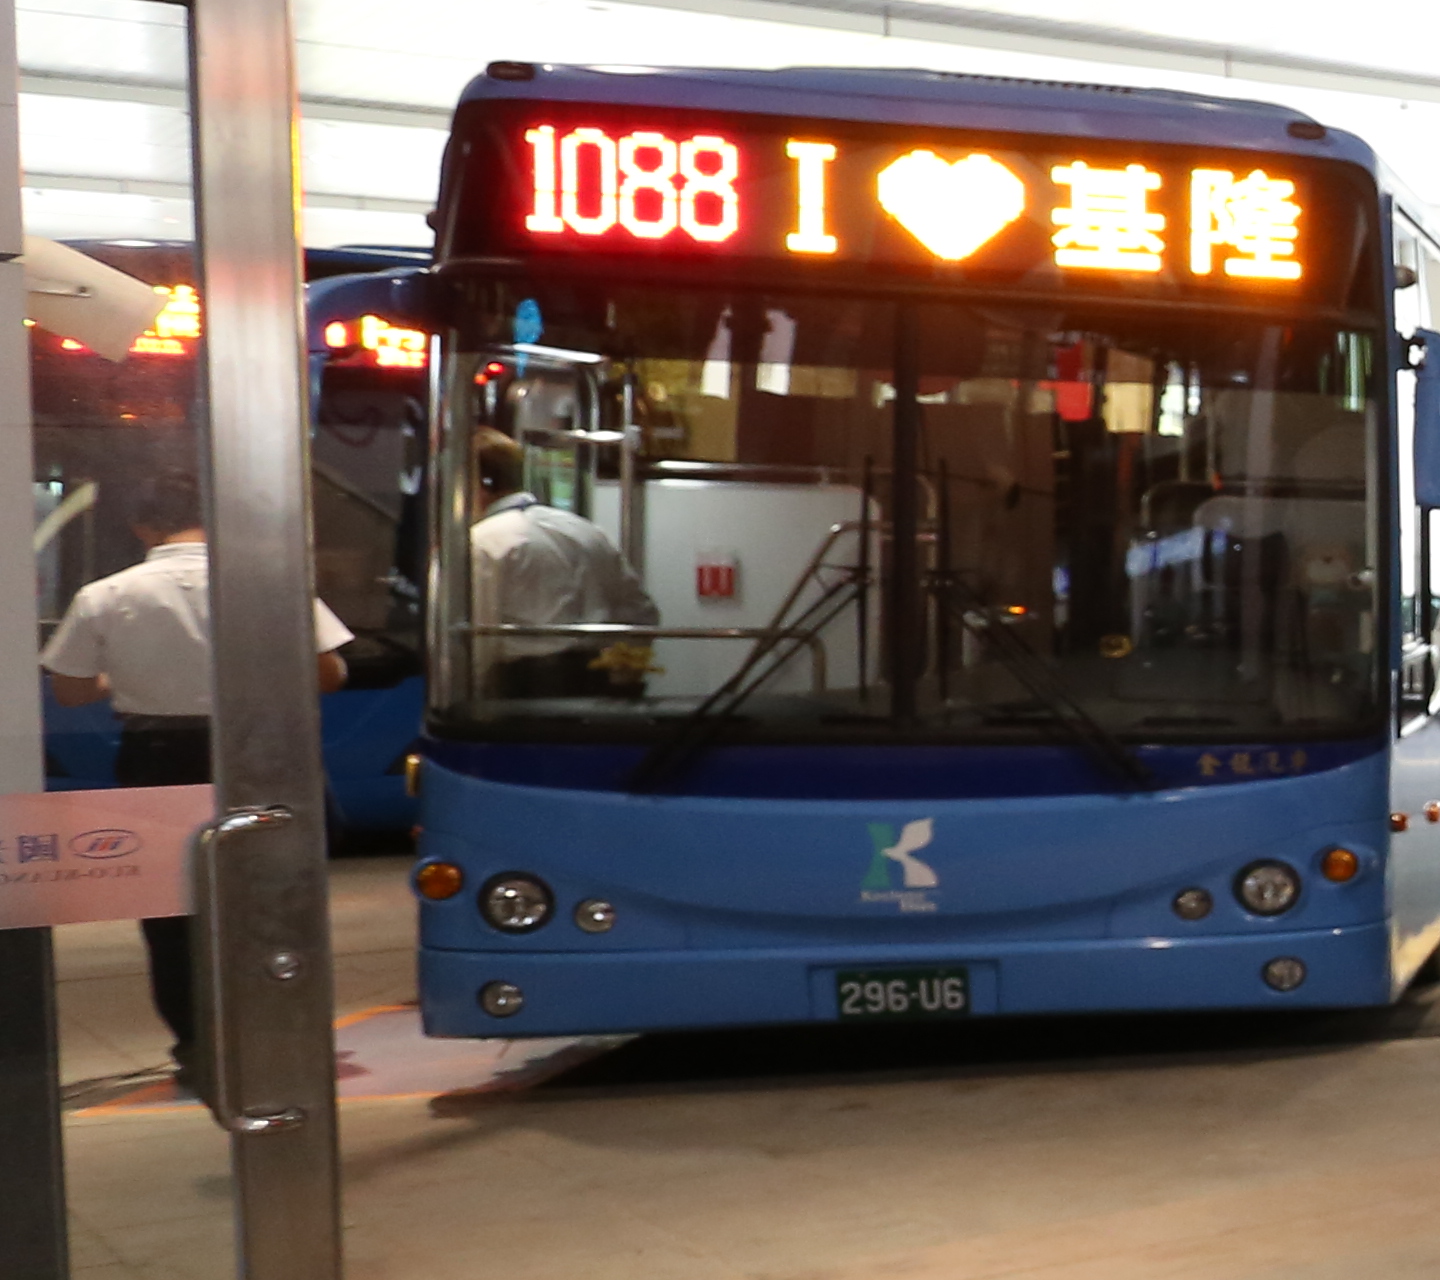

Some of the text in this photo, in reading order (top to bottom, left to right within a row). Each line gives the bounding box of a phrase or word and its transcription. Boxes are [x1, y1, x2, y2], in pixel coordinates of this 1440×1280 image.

[525, 124, 1304, 281] 1088 I 基隆
[839, 976, 966, 1015] 296-U6
